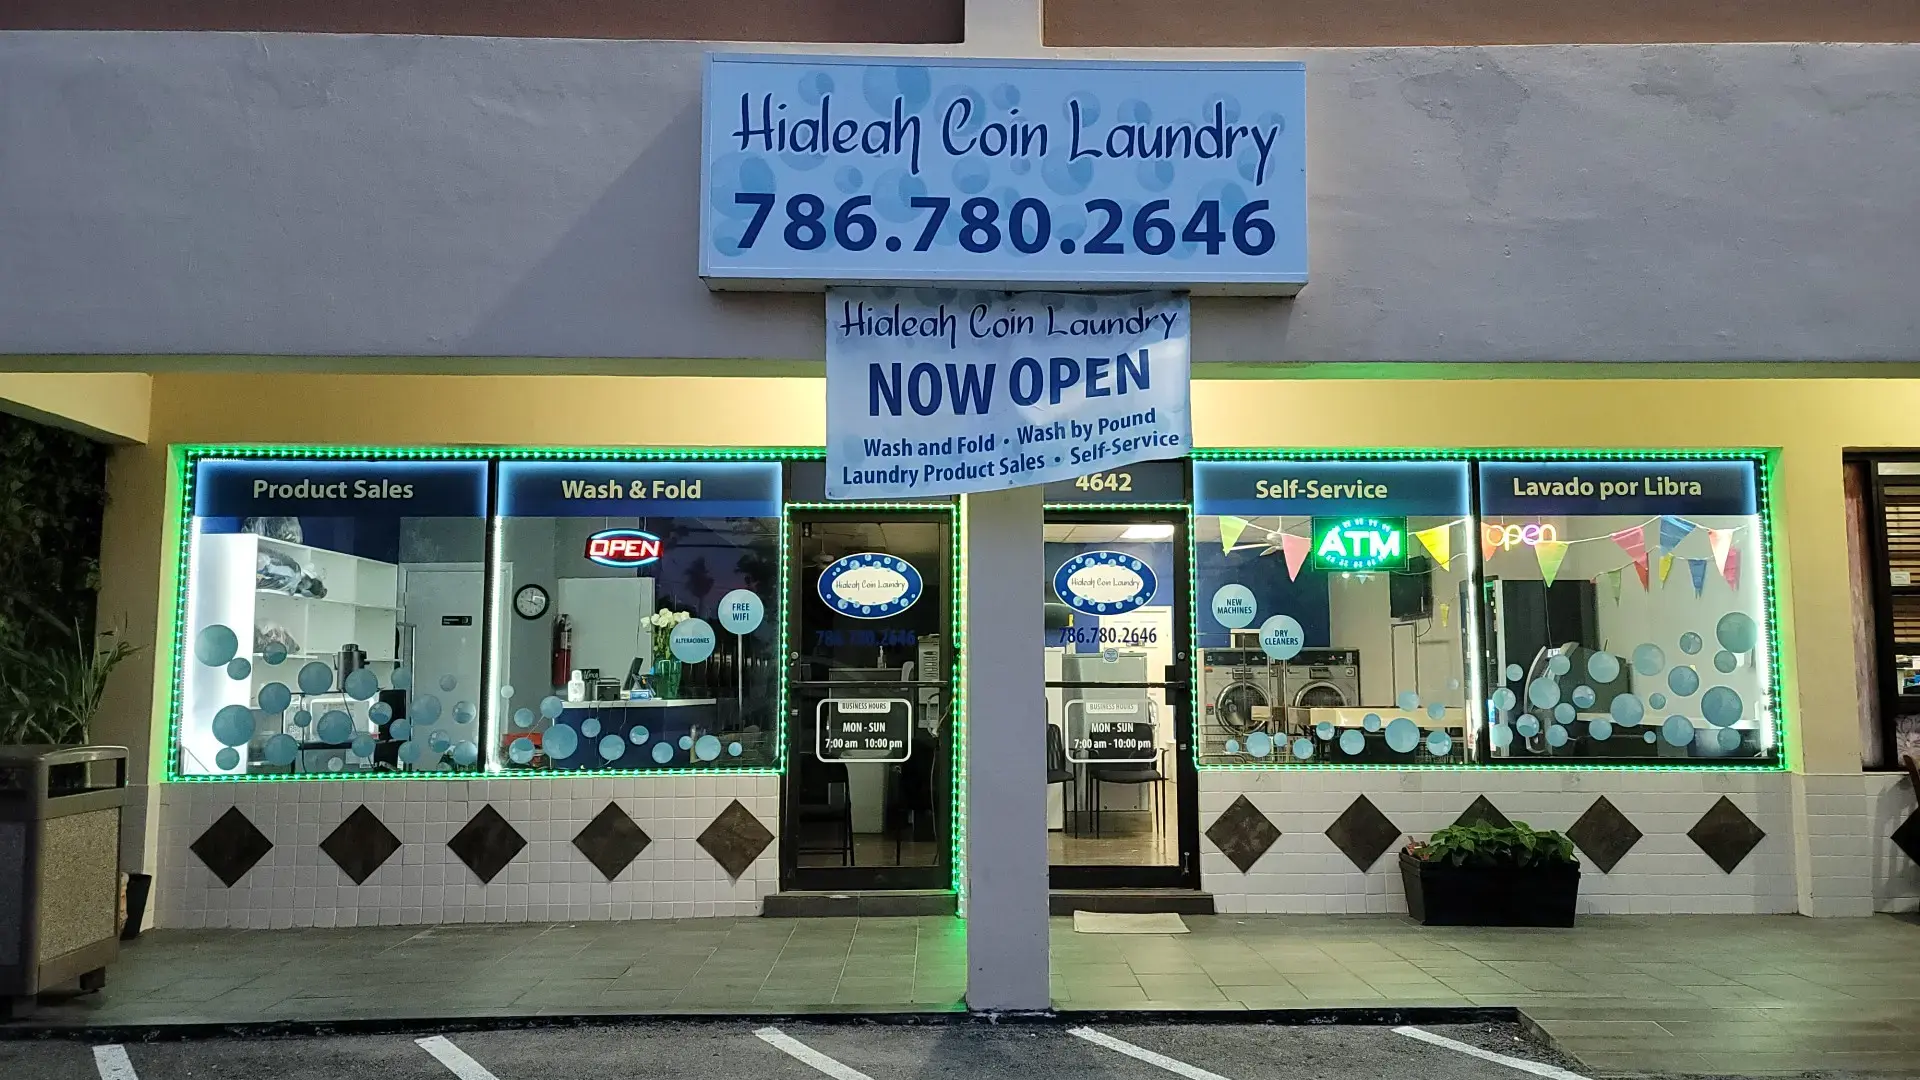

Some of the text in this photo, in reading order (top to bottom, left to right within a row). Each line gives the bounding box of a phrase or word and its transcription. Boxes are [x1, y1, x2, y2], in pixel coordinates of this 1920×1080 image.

[733, 93, 1279, 185] Hialeah Coin Laundry
[734, 193, 1276, 256] 786.780.2646
[840, 301, 1177, 349] Hialeah Coin Laundry
[869, 349, 1150, 417] NOW OPEN
[864, 407, 1155, 457] Wash and Fold Wash by Pound
[843, 431, 1180, 488] Laundry Product Sales Self-Service
[253, 478, 414, 499] Product Sales
[561, 479, 701, 499] Wash & Fold
[1075, 473, 1133, 492] 4642
[1256, 479, 1388, 499] Self-Service
[1513, 476, 1702, 500] Lavado por Libra
[589, 539, 661, 557] OPEN
[1317, 525, 1400, 558] ATM
[878, 580, 906, 591] Laundry
[1113, 578, 1140, 590] Laundry
[732, 603, 750, 611] FREE
[732, 612, 749, 621] WIFI
[1060, 627, 1157, 644] 786.780.2646
[1264, 638, 1299, 646] CLEANERS
[1274, 629, 1288, 637] DRY
[842, 722, 862, 732] MON
[868, 722, 886, 732] SUN
[1091, 722, 1111, 732] MON
[1117, 722, 1134, 732] SUN
[825, 738, 843, 748] 7:00
[864, 738, 888, 748] 10:00
[889, 741, 903, 751] pm
[1074, 738, 1092, 748] 7:00
[1113, 738, 1136, 748] 10:00
[1137, 741, 1151, 750] pm
